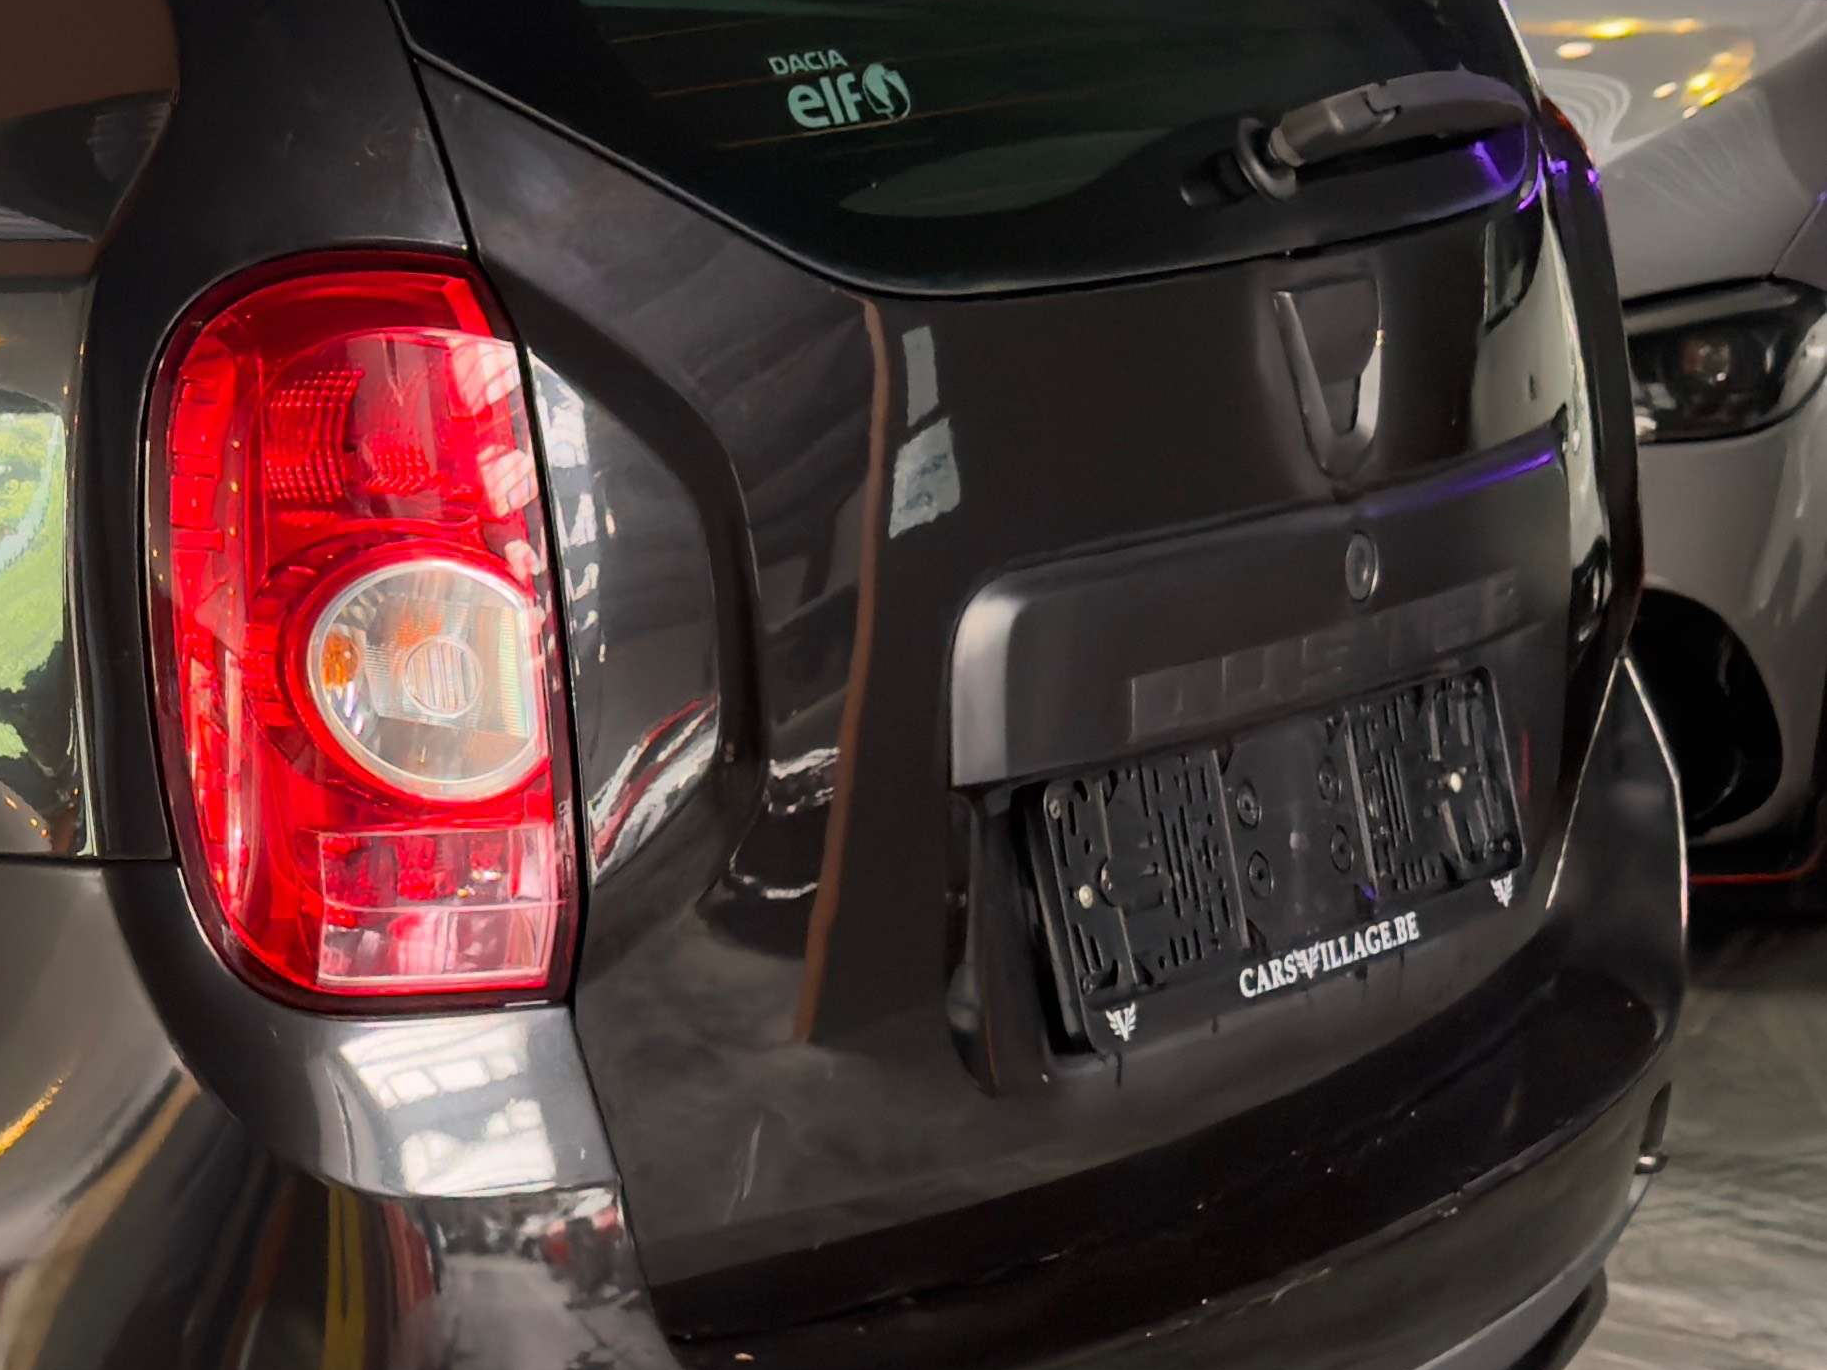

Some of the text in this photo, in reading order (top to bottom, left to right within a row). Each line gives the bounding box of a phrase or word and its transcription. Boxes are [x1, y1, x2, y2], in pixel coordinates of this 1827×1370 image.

[768, 49, 848, 76] DACIA
[787, 72, 863, 129] elf
[1239, 911, 1420, 998] CARSVILLAGE.BE
